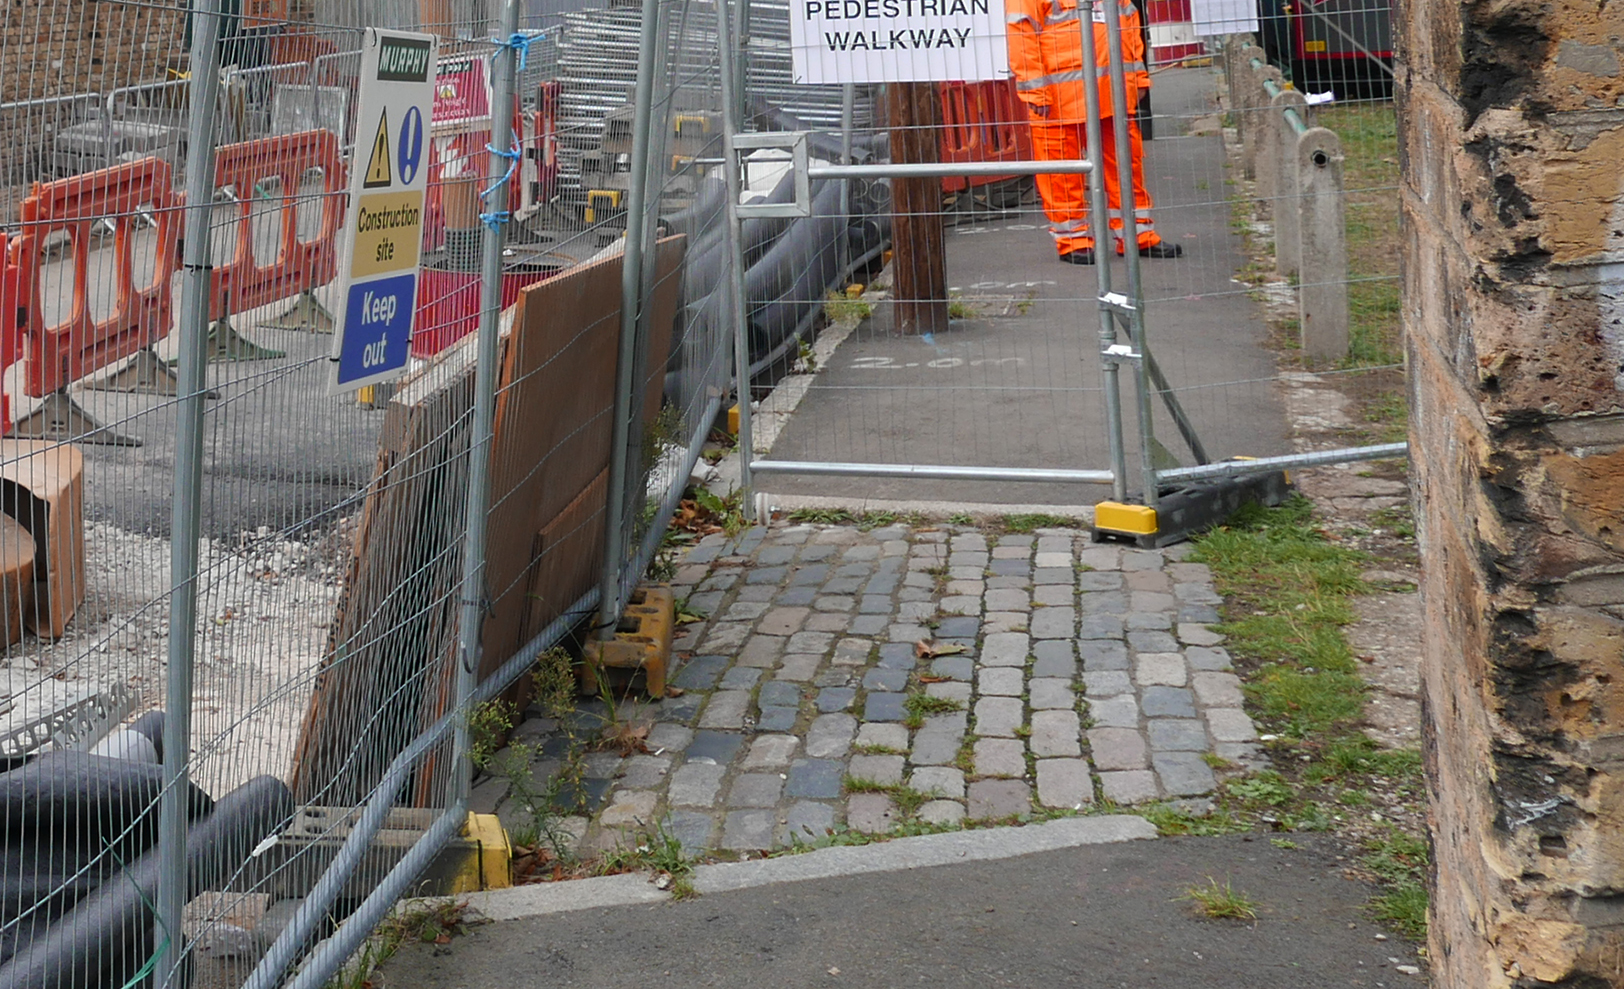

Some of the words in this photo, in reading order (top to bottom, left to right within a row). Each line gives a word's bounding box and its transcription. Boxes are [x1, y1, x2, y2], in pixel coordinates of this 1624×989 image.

[824, 28, 971, 52] WALKWAY
[380, 45, 429, 74] MURPHY
[358, 203, 419, 233] Construction
[376, 239, 394, 262] site
[361, 290, 397, 327] Keep
[362, 331, 388, 369] out
